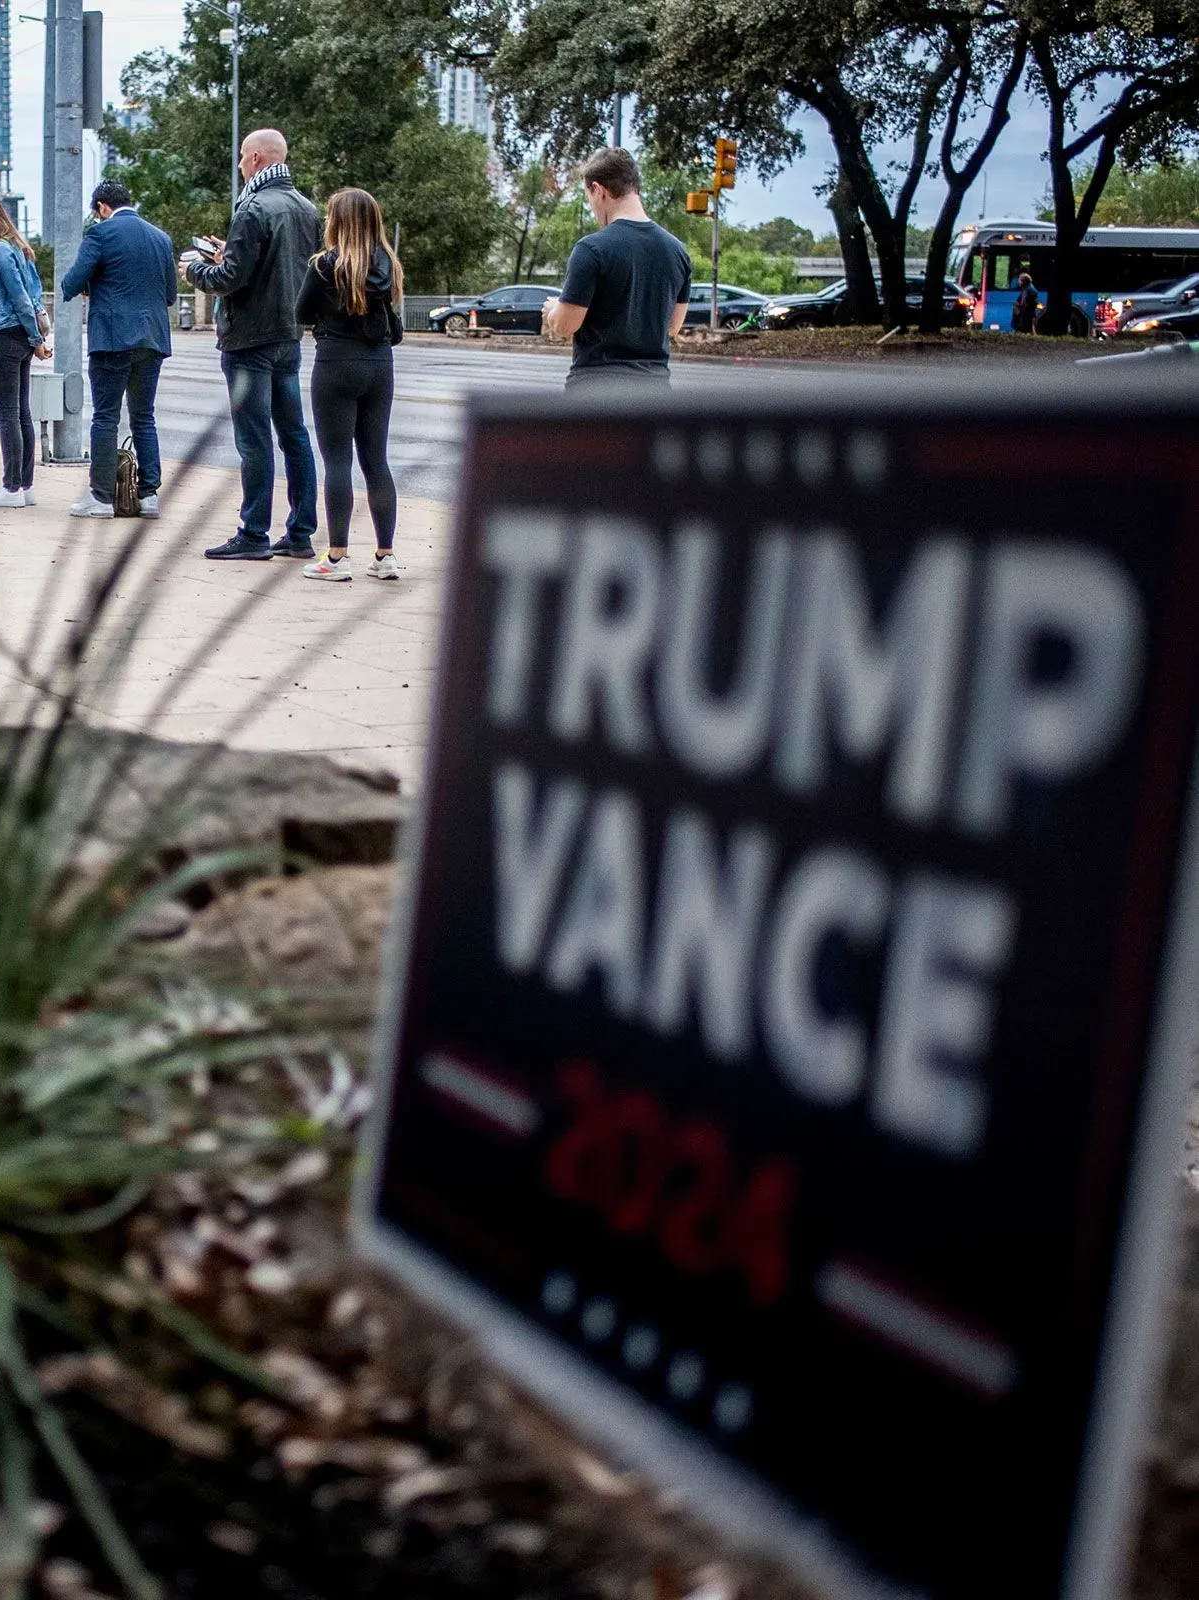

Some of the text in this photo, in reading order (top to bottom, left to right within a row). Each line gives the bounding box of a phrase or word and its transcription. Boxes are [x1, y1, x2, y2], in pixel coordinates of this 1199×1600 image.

[485, 505, 1147, 832] TRUMP
[491, 762, 1019, 1158] VANCE
[541, 1058, 798, 1308] 2024
